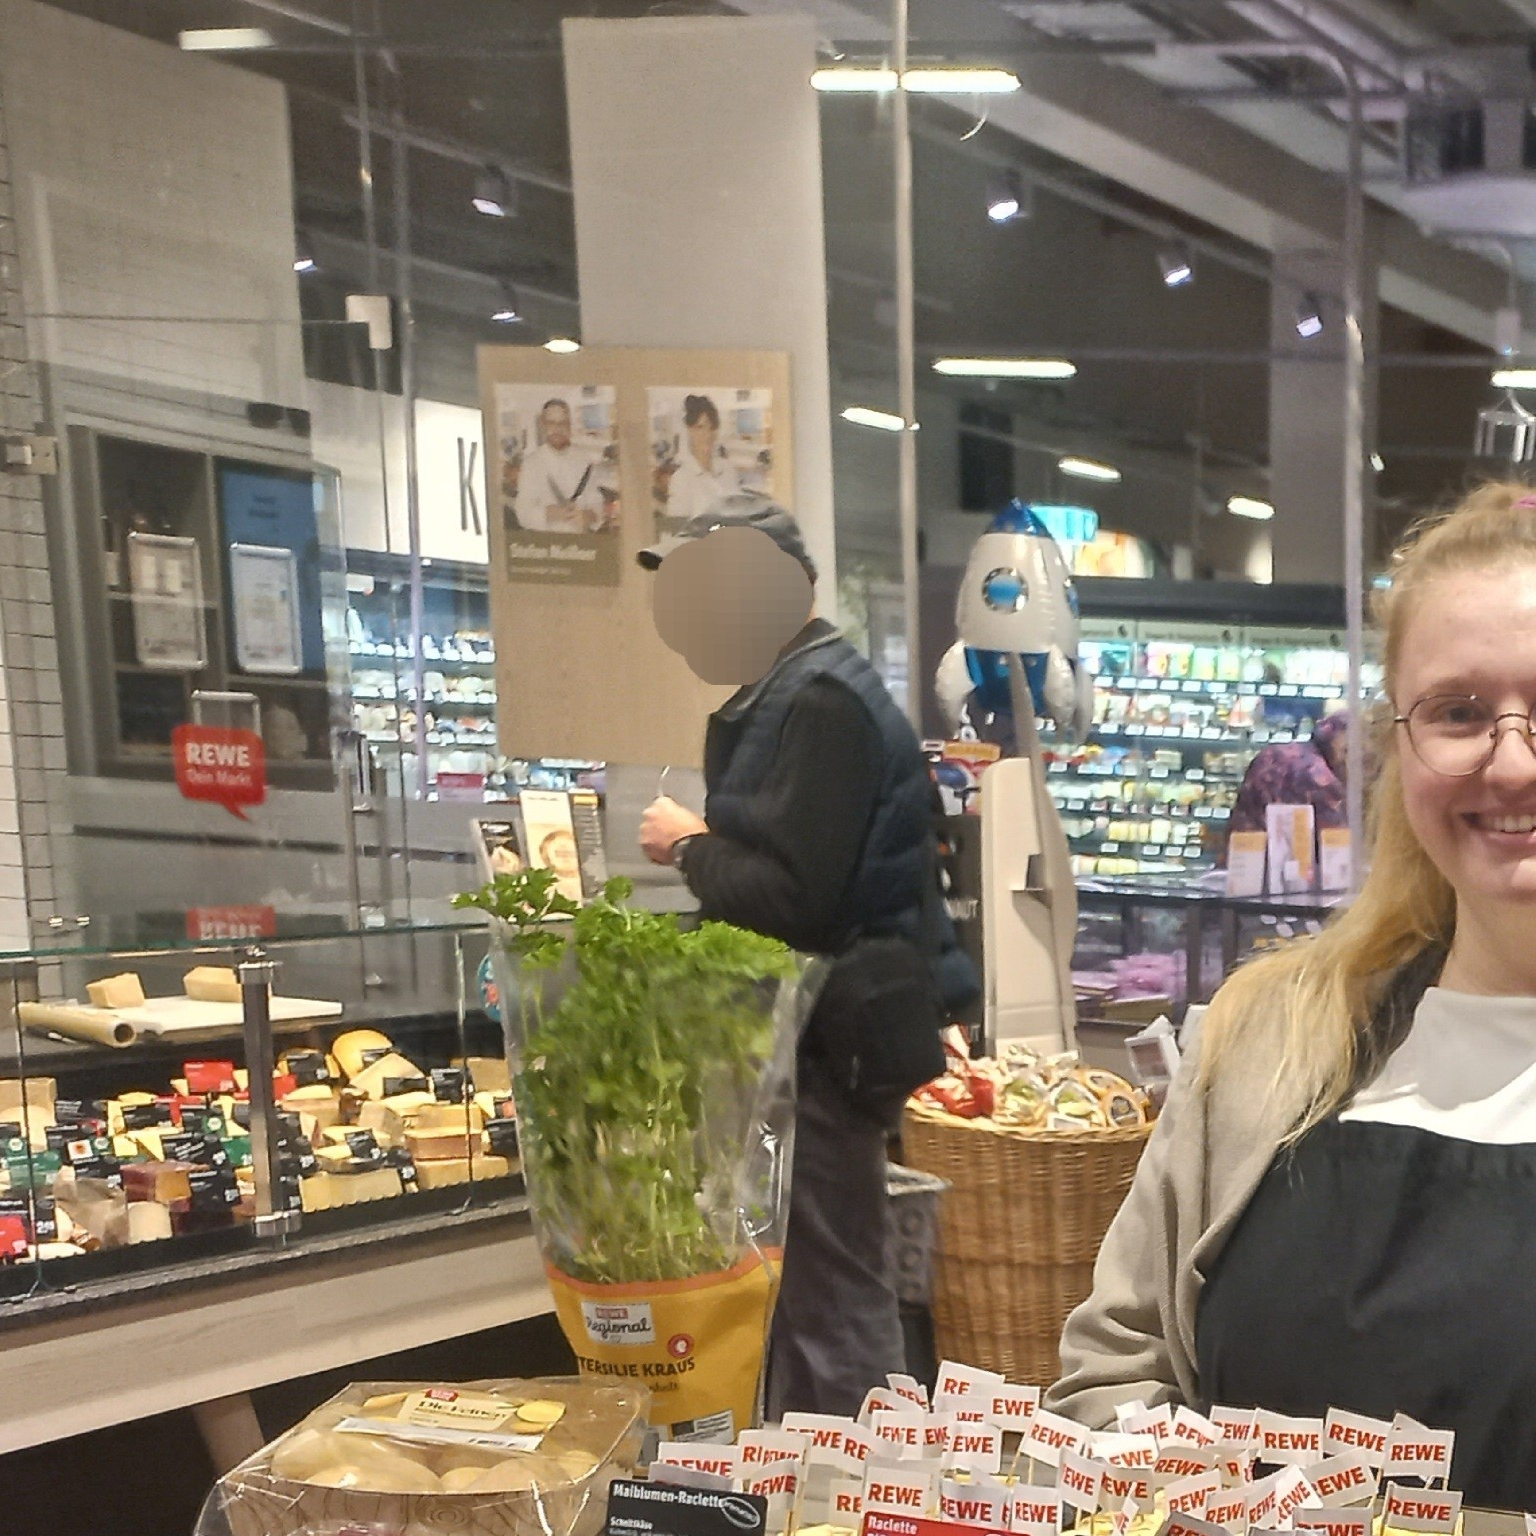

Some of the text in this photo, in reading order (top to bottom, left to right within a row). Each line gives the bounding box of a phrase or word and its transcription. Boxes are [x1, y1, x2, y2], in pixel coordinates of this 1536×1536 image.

[185, 743, 250, 767] REWE
[643, 1357, 696, 1378] KRAUS
[992, 1398, 1035, 1418] EWE
[953, 1435, 994, 1453] EWE
[1265, 1432, 1319, 1450] REWE
[1329, 1423, 1387, 1452] REWE
[1109, 1449, 1154, 1468] EWE
[1391, 1444, 1446, 1462] REWE
[752, 1475, 798, 1497] REWE
[1062, 1464, 1095, 1497] EWE
[613, 1483, 725, 1508] Maiblumen-Raclette
[868, 1483, 923, 1508] REWE
[1015, 1502, 1058, 1523] REWE
[1388, 1496, 1451, 1522] REWE
[868, 1515, 918, 1535] Raclette
